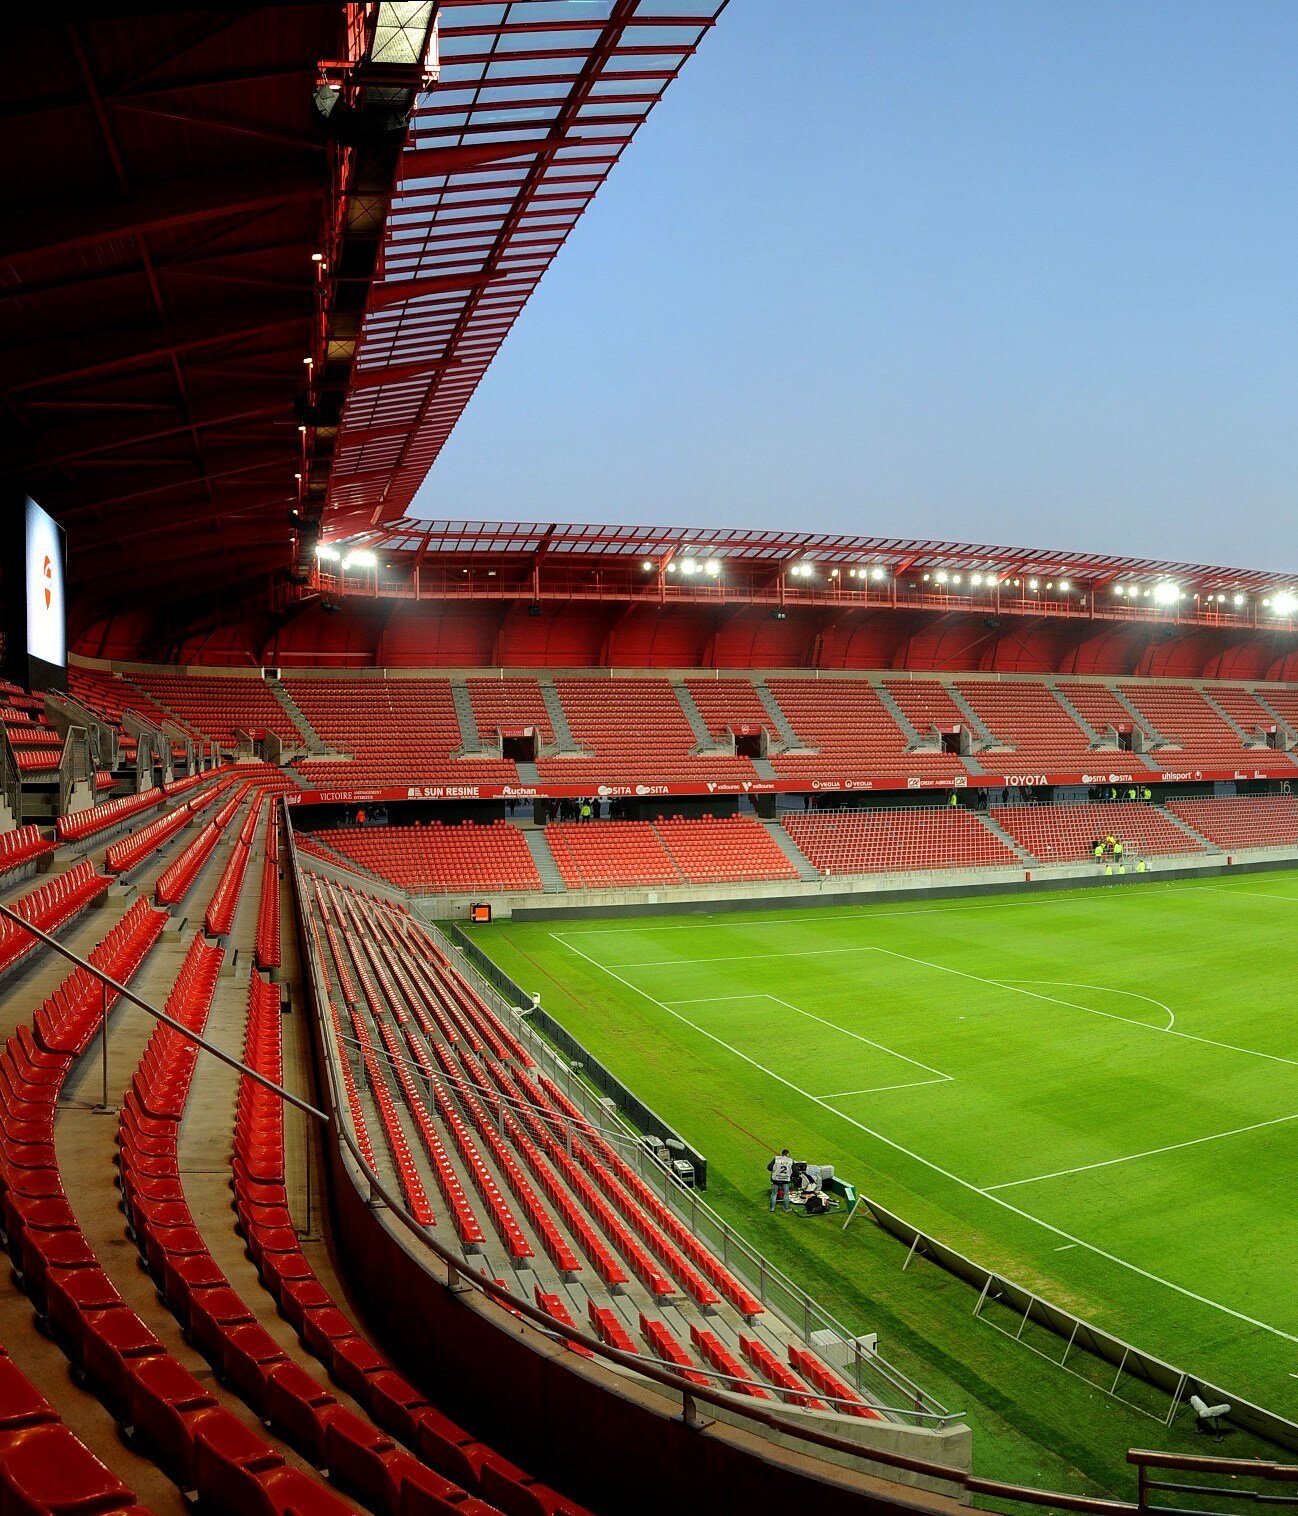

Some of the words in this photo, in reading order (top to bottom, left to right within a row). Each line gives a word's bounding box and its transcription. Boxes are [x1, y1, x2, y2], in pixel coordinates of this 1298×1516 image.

[1004, 775, 1048, 786] TOYOTA
[1092, 775, 1106, 783] SITA
[1119, 774, 1132, 782] SITA
[1162, 772, 1192, 781] uhlsport
[424, 787, 443, 796] SUN
[446, 787, 480, 796] RESINE
[502, 786, 536, 795] Auchan
[613, 786, 632, 795] SITA
[650, 785, 669, 794] SITA
[1280, 781, 1291, 793] 16
[320, 791, 352, 800] VICTOIRE
[780, 1166, 787, 1174] 2
